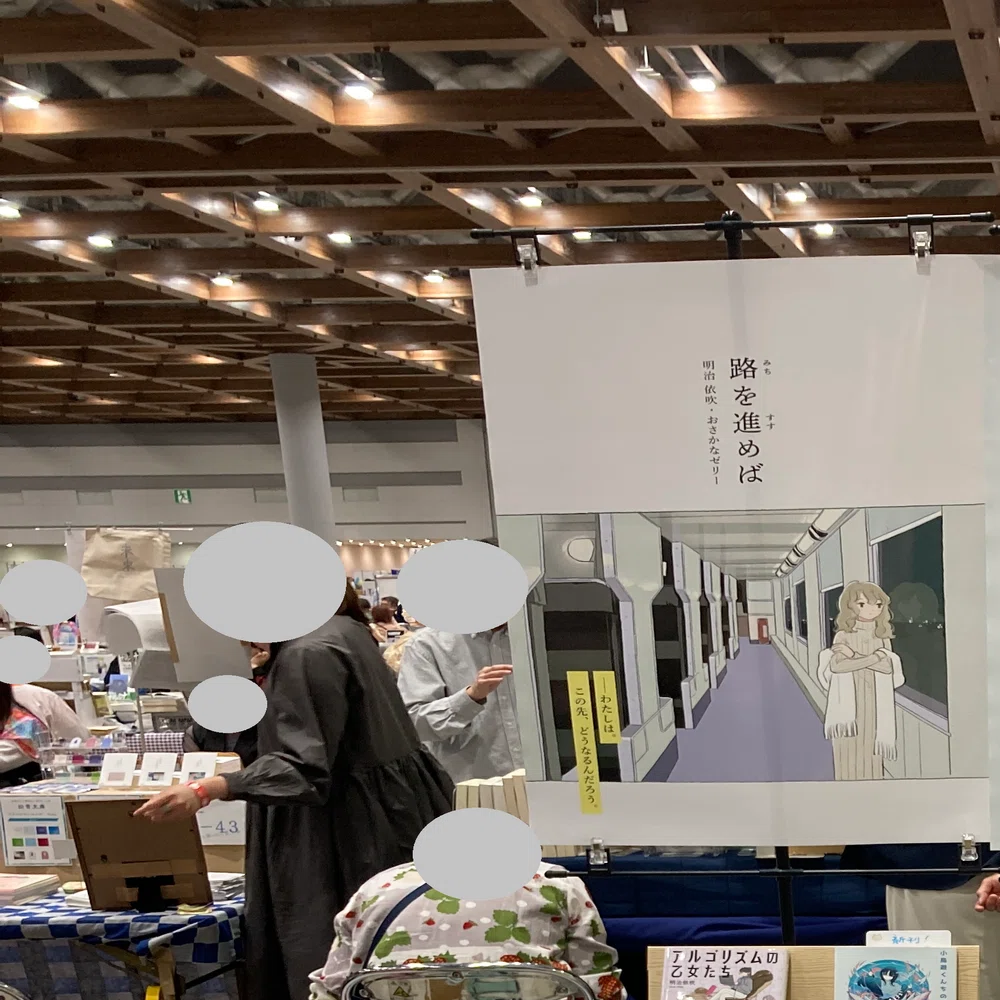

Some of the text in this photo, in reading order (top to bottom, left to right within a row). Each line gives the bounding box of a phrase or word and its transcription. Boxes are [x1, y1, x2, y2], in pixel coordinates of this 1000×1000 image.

[730, 357, 763, 484] 路を進めば
[575, 687, 598, 808] この先、どうなるんだろう。
[671, 964, 731, 978] 乙女たち
[672, 949, 779, 964] アルゴリズムの
